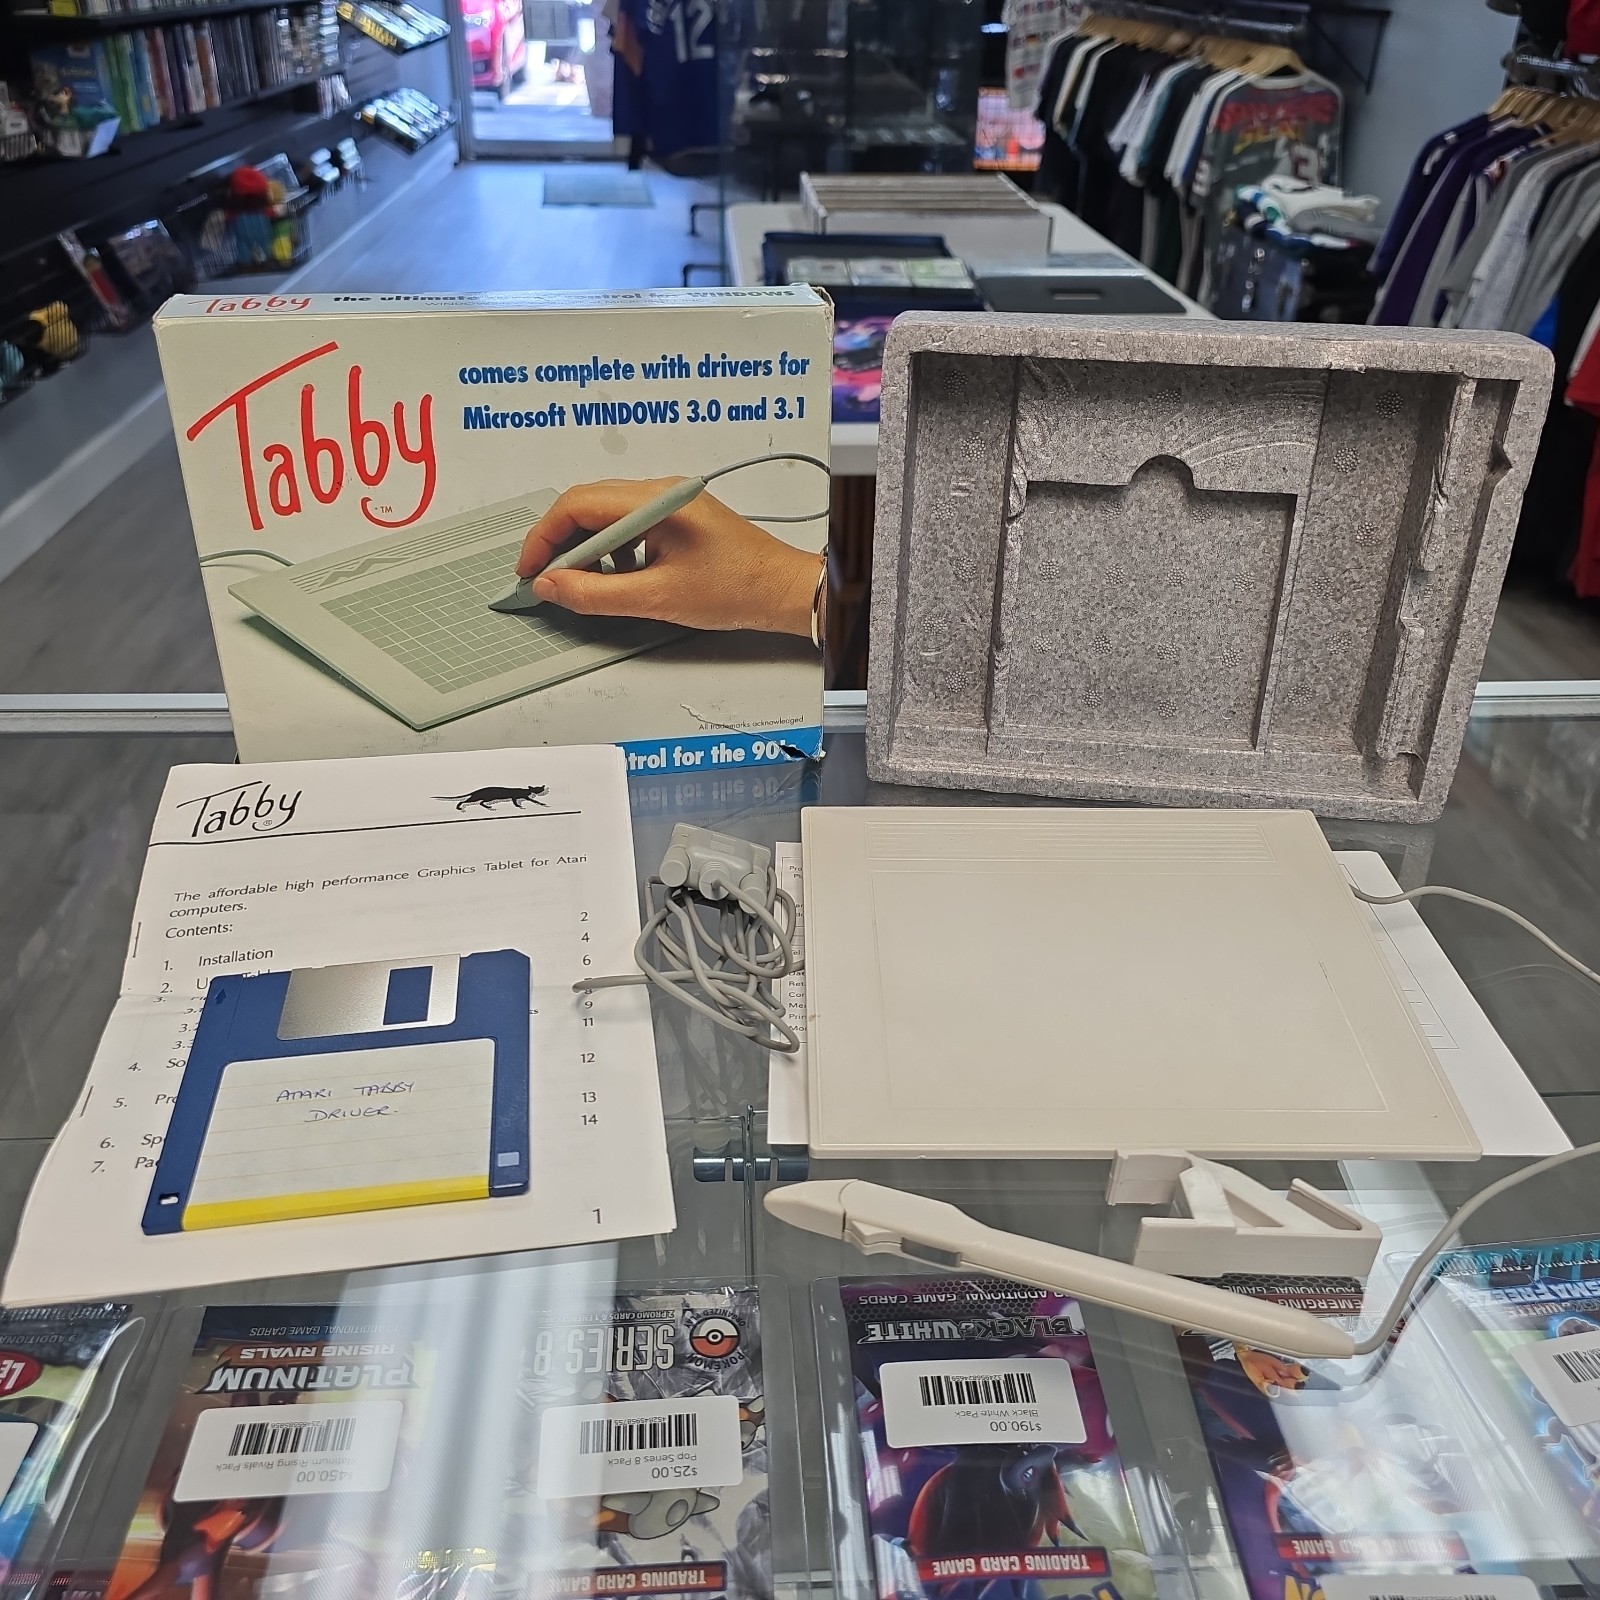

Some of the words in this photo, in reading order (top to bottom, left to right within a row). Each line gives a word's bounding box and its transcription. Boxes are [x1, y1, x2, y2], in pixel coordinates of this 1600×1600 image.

[669, 0, 715, 64] 12
[188, 294, 313, 314] Tabby
[459, 364, 528, 385] comes
[535, 356, 636, 389] complete
[641, 354, 691, 380] with
[699, 353, 773, 378] drivers
[779, 351, 811, 376] for
[463, 403, 567, 430] Microsoft
[572, 400, 680, 427] WINDOWS
[686, 399, 721, 424] 3.0
[727, 397, 768, 421] and
[774, 396, 806, 420] 3.1
[187, 340, 437, 530] Tabby
[698, 722, 709, 731] All
[710, 721, 751, 731] trademarks
[752, 715, 805, 729] acknowledged
[672, 745, 704, 766] for
[711, 742, 745, 764] the
[176, 780, 303, 838] Tabby
[174, 892, 201, 902] The
[208, 882, 278, 900] affordable
[285, 879, 315, 893] high
[321, 870, 410, 890] performance
[417, 864, 477, 879] Graphics
[484, 859, 524, 872] Tablet
[531, 857, 551, 867] for
[556, 854, 588, 865] Atari
[169, 901, 248, 918] computers.
[580, 911, 589, 922] 2
[165, 922, 234, 939] Contents:
[581, 932, 590, 943] 4
[163, 960, 174, 971] 1.
[198, 948, 274, 967] Installation
[582, 954, 592, 966] 6
[160, 982, 174, 994] 2.
[584, 1000, 593, 1010] 9
[582, 1017, 594, 1027] 11
[580, 1052, 595, 1064] 12
[128, 1062, 142, 1072] 4.
[276, 1088, 333, 1103] ATARI
[353, 1081, 415, 1097] TABBY
[581, 1091, 597, 1103] 13
[113, 1097, 128, 1108] 5.
[581, 1114, 599, 1126] 14
[100, 1137, 116, 1149] 6.
[91, 1160, 106, 1173] 7.
[592, 1207, 602, 1225] 1
[858, 1294, 908, 1305] CARDS
[912, 1293, 956, 1304] GAME
[1278, 1298, 1365, 1310] EMERGING
[609, 1311, 636, 1320] CARDS
[637, 1310, 667, 1320] PROMO
[701, 1307, 747, 1328] ORGANIZED
[249, 1326, 286, 1336] CARDS
[288, 1326, 320, 1336] GAME
[240, 1346, 318, 1359] RIVALS
[321, 1343, 396, 1357] RISING
[533, 1329, 554, 1376] 8
[565, 1323, 676, 1374] SERIES
[685, 1350, 746, 1373] POKÉMON
[203, 1361, 413, 1392] PLATINUM
[954, 1409, 979, 1418] Pack
[980, 1409, 1010, 1418] White
[1012, 1408, 1039, 1418] Black
[989, 1419, 1042, 1433] $190.00
[277, 1458, 308, 1469] Rising
[607, 1456, 632, 1466] Pack
[634, 1455, 641, 1465] 8
[644, 1454, 675, 1464] Series
[677, 1453, 698, 1463] Pop
[216, 1463, 241, 1472] Pack
[244, 1460, 275, 1470] Rivals
[651, 1465, 698, 1480] $25.00
[1291, 1539, 1335, 1556] GAME
[932, 1558, 976, 1576] GAME
[980, 1555, 1020, 1573] CARD
[1025, 1553, 1091, 1572] TRADING
[550, 1575, 592, 1592] GAM
[595, 1571, 636, 1589] CARD
[641, 1568, 707, 1588] TRADING
